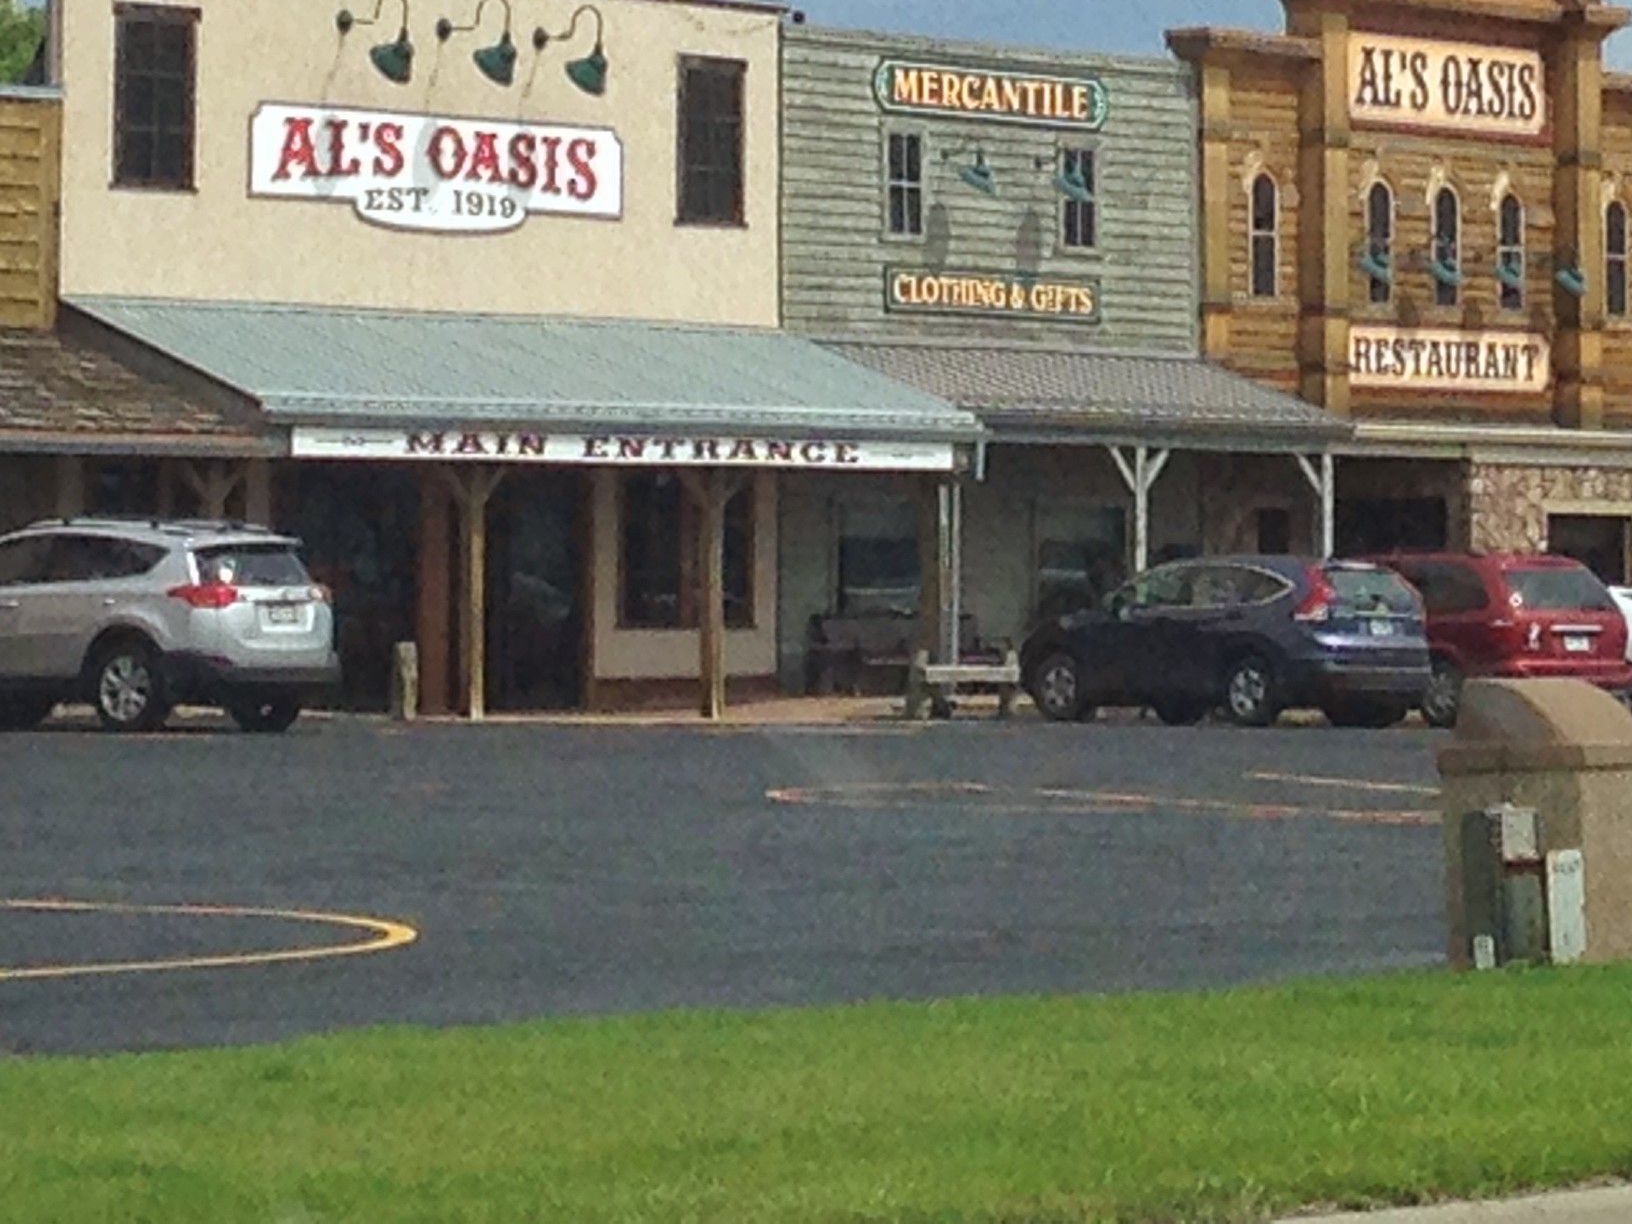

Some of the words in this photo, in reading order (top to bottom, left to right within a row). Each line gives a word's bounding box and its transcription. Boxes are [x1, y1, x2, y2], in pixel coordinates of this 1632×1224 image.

[893, 67, 1089, 120] MERCANTILE
[1355, 45, 1430, 111] AL'S
[1440, 54, 1537, 121] OASIS
[270, 116, 405, 182] AL'S
[426, 125, 598, 201] OASIS
[452, 188, 518, 219] 1919
[893, 274, 1006, 308] CLOTHING
[1009, 282, 1026, 310] &
[1030, 283, 1094, 315] GIFTS
[1350, 334, 1540, 381] RESTAURANT
[403, 432, 548, 456] MAIN
[580, 435, 860, 464] ENTRANCE
